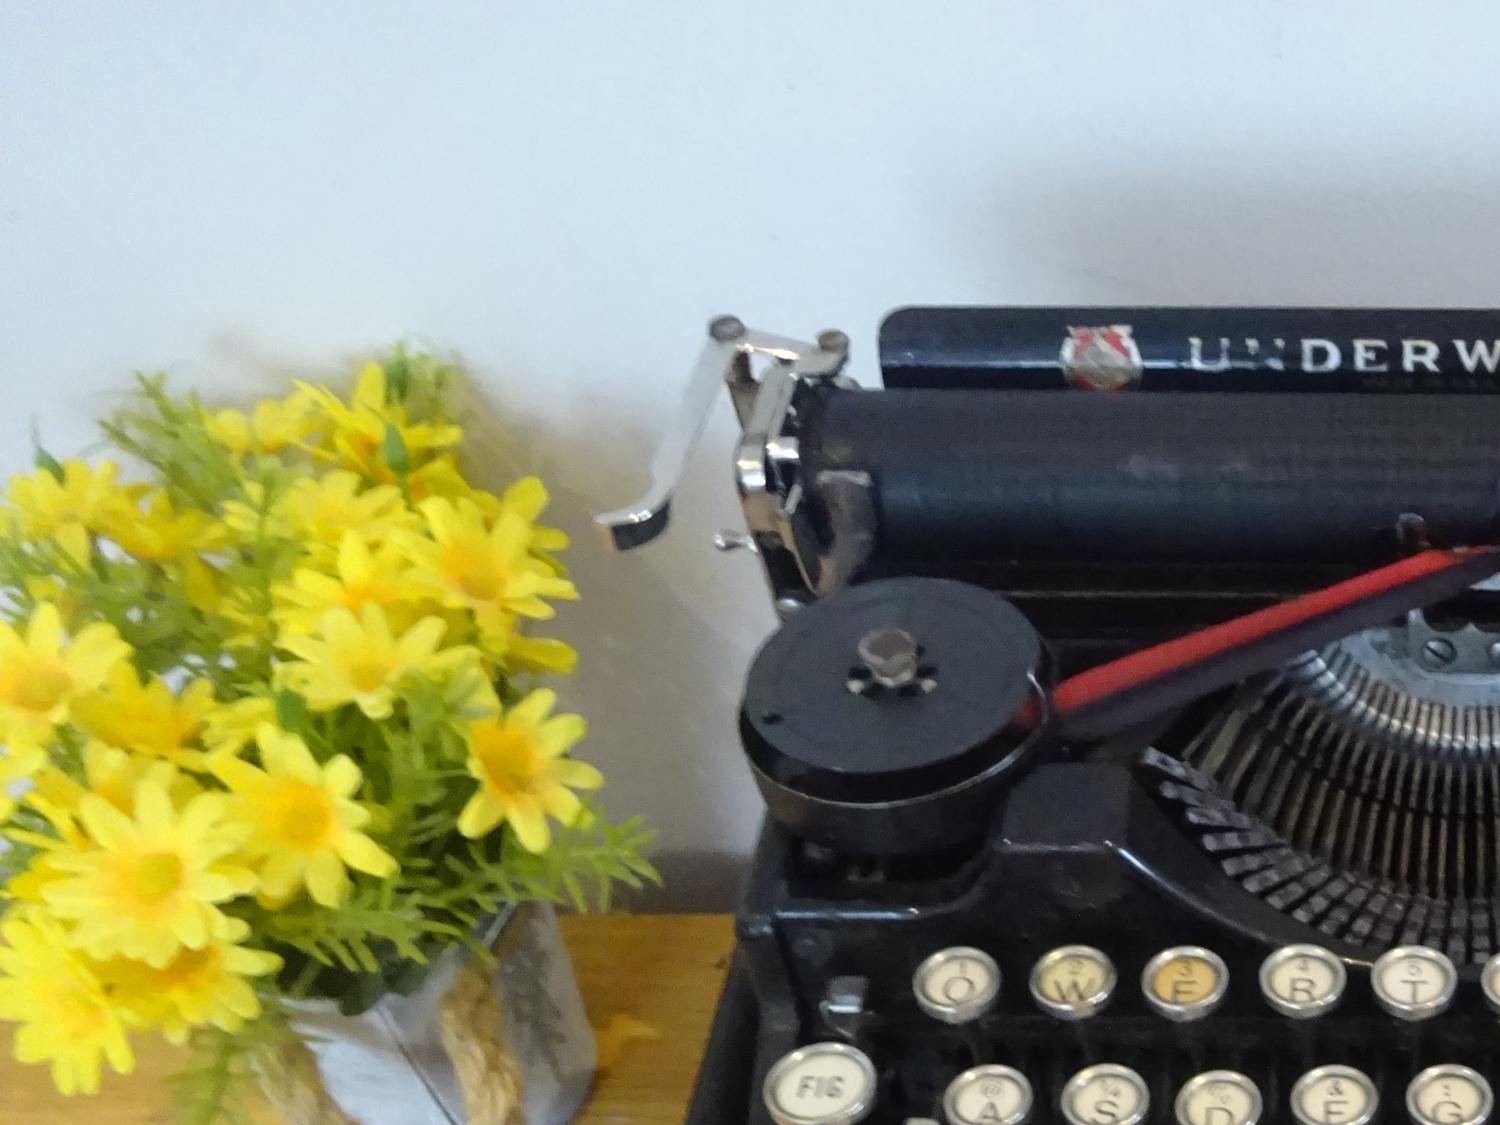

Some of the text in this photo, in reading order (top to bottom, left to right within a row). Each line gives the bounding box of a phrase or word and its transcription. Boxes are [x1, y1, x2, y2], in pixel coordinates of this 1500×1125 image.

[1175, 958, 1193, 976] 3
[1406, 960, 1424, 976] 5
[1053, 978, 1097, 1003] W
[1289, 977, 1317, 1002] R
[1398, 979, 1428, 1004] T
[796, 1075, 847, 1099] FIG
[1326, 1079, 1344, 1096] &
[977, 1100, 1002, 1123] A
[1093, 1099, 1120, 1123] S
[1322, 1099, 1349, 1124] F
[1431, 1100, 1463, 1123] G
